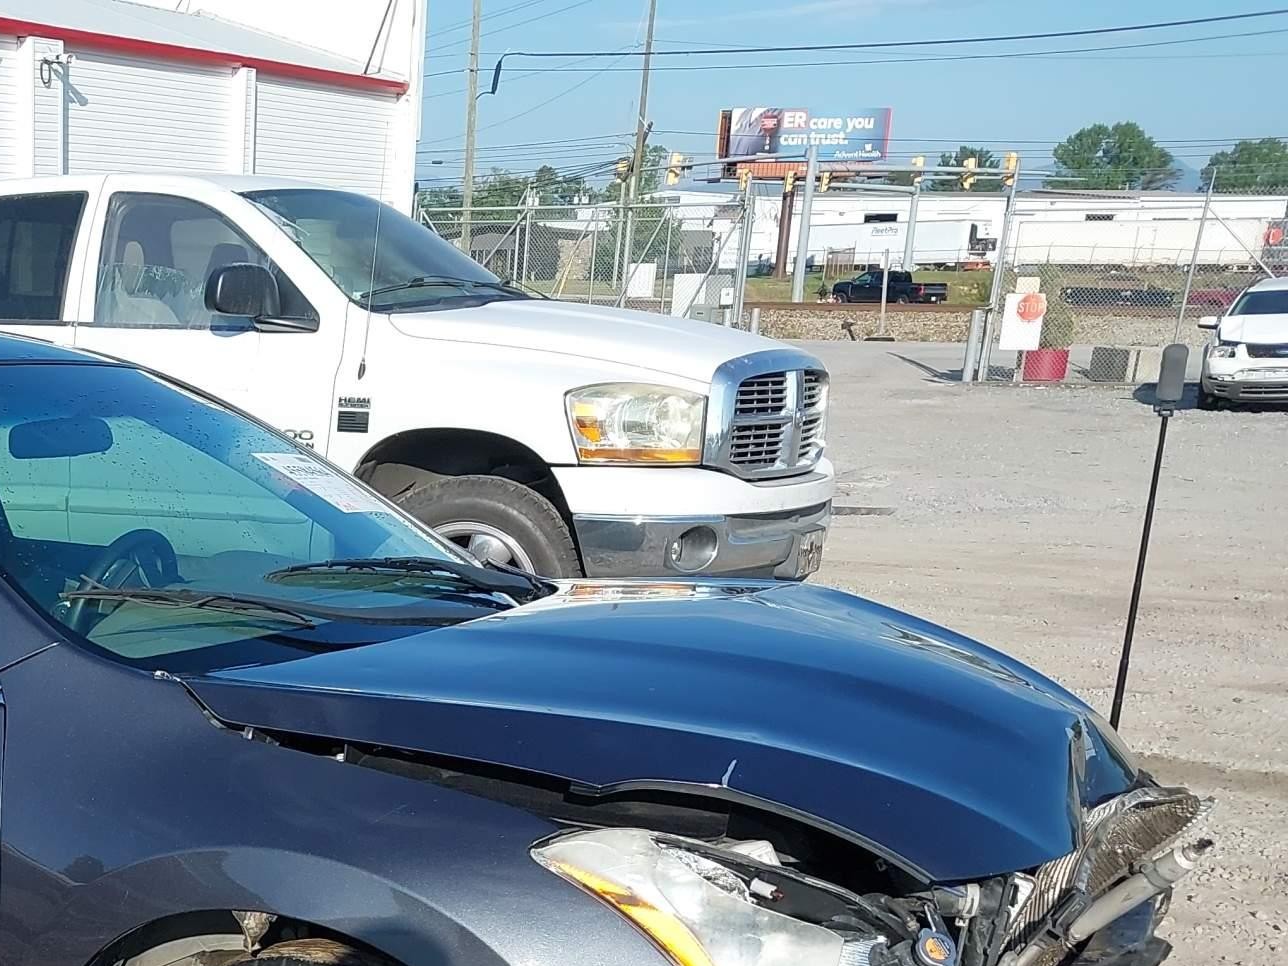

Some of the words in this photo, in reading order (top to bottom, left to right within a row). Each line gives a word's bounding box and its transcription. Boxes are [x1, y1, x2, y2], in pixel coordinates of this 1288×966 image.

[784, 112, 807, 128] ER
[809, 117, 842, 130] care
[846, 118, 874, 133] you
[779, 134, 808, 146] can
[809, 131, 849, 145] trust.
[1018, 302, 1045, 313] STOP
[338, 396, 371, 404] HEMI
